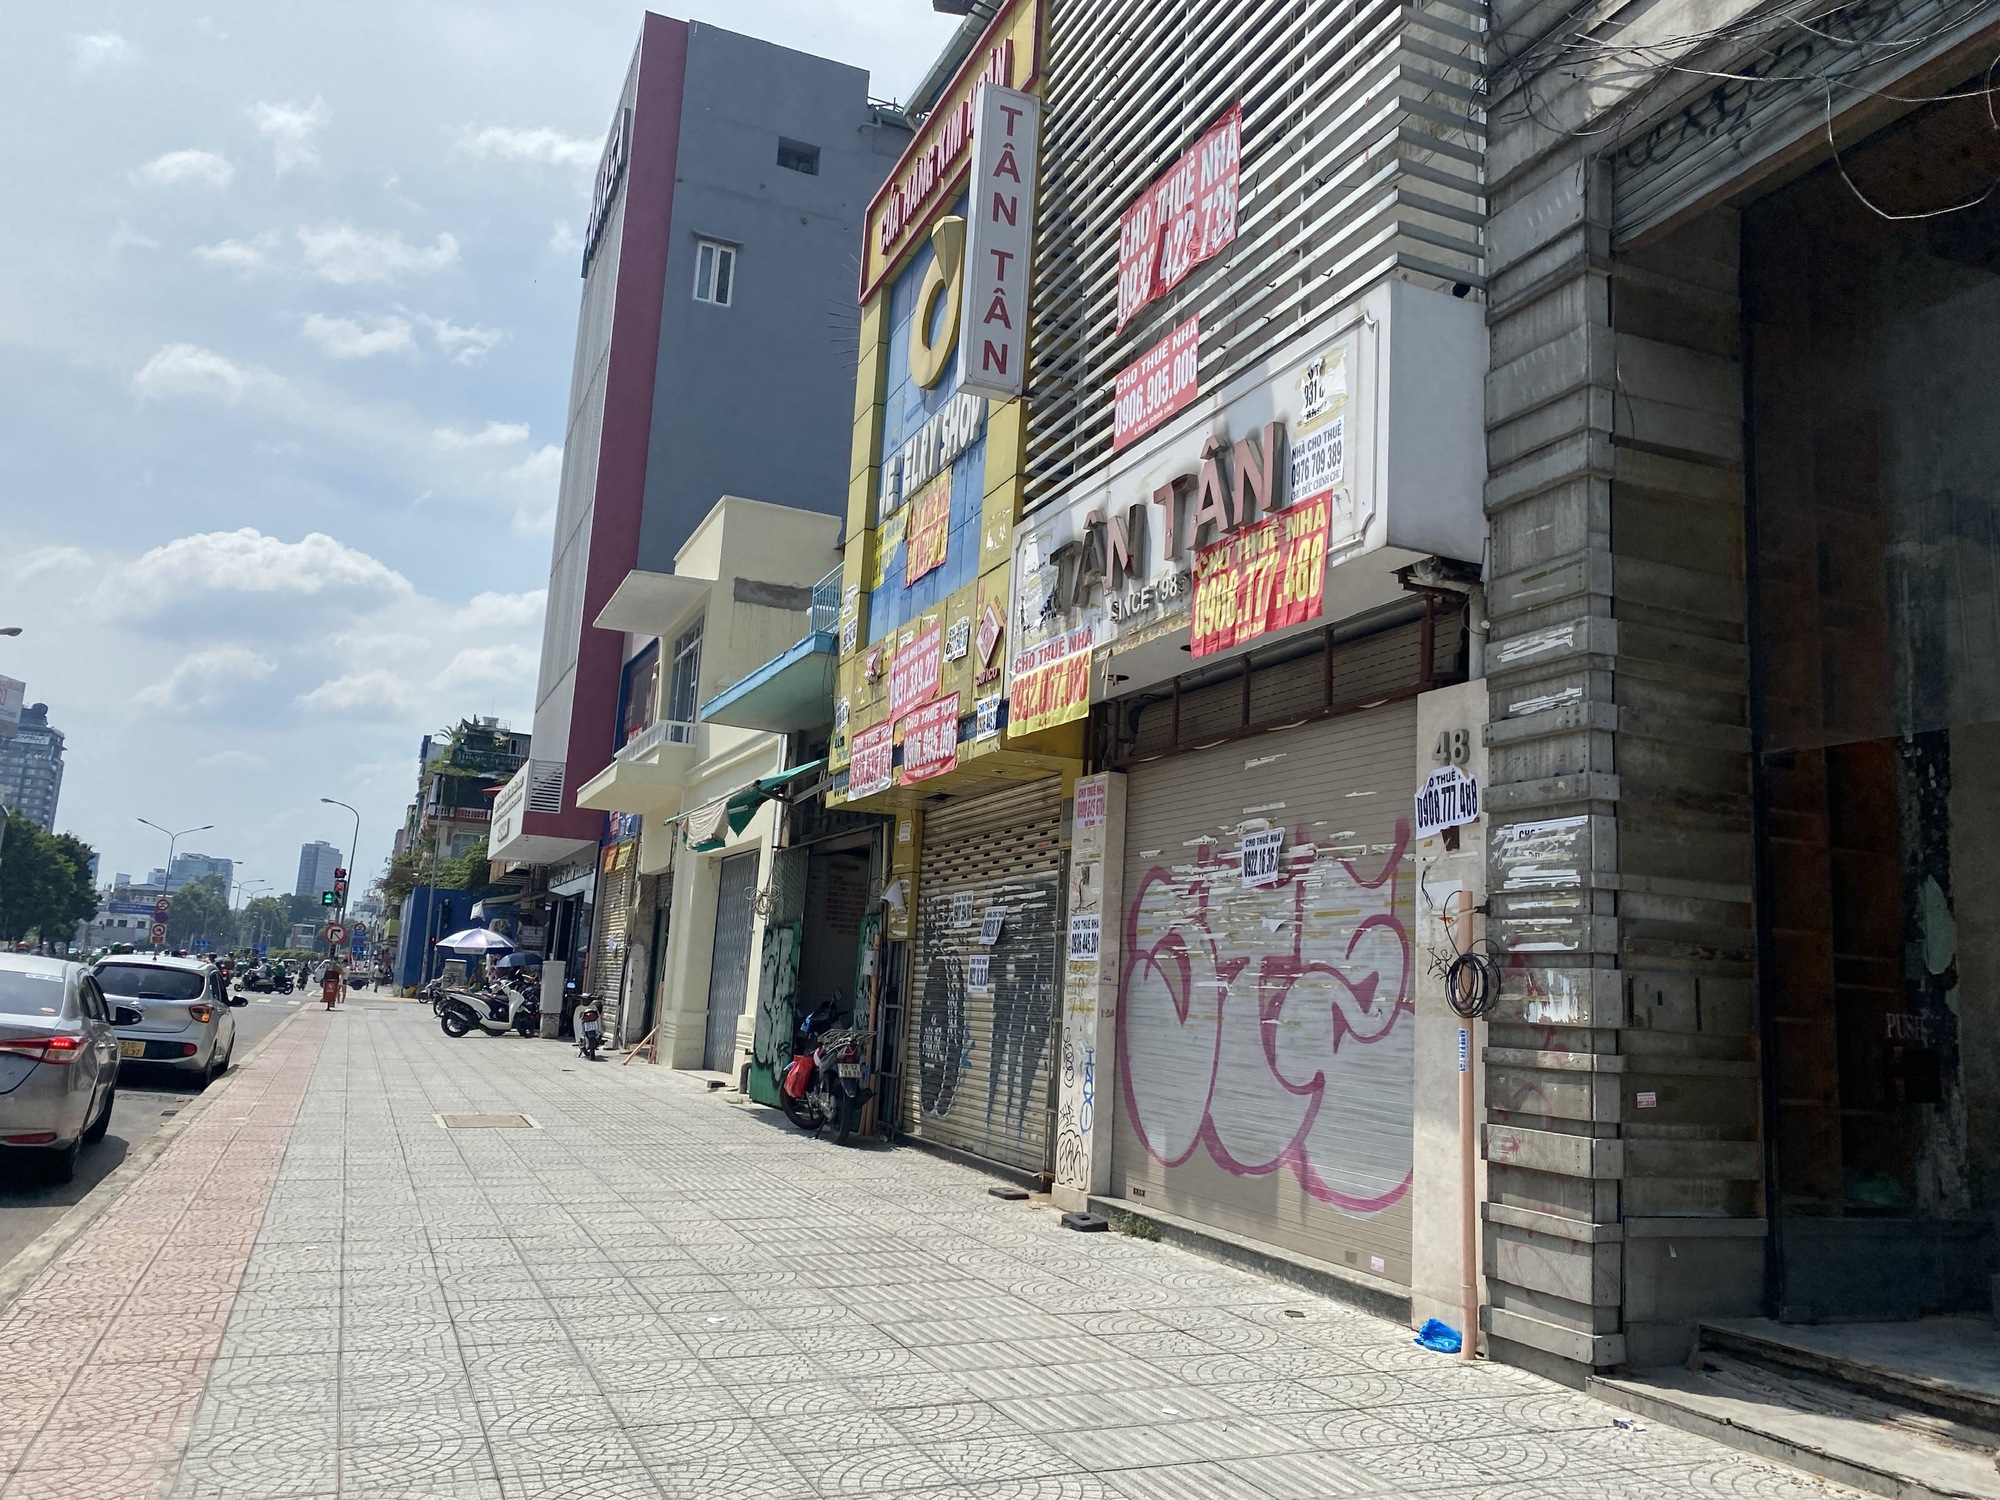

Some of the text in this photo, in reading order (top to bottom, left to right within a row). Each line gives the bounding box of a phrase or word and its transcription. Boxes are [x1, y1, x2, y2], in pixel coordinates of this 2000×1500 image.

[937, 101, 968, 178] KIM
[1120, 112, 1239, 265] CHO THUÊ NHÀ
[983, 105, 1023, 375] TÂN TÂN
[1116, 317, 1198, 395] CHO THUÊ NHÀ
[1115, 342, 1197, 438] 0906.905.006
[940, 393, 984, 467] SHOP
[1291, 419, 1343, 461] NHÀ CHO THUÊ
[1291, 439, 1342, 489] 0976 709 389
[1050, 503, 1146, 617] TÂN
[1154, 421, 1286, 562] TÂN
[1196, 498, 1326, 580] CHO THUÊ NHÀ
[1110, 588, 1150, 625] SINCE
[1014, 625, 1094, 675] CHO THUÊ NHÀ
[1432, 729, 1470, 766] 48
[1436, 768, 1456, 785] THUÊ
[1417, 779, 1478, 829] 0908.777.488
[1246, 838, 1256, 847] CHO
[1257, 834, 1269, 846] THUÊ
